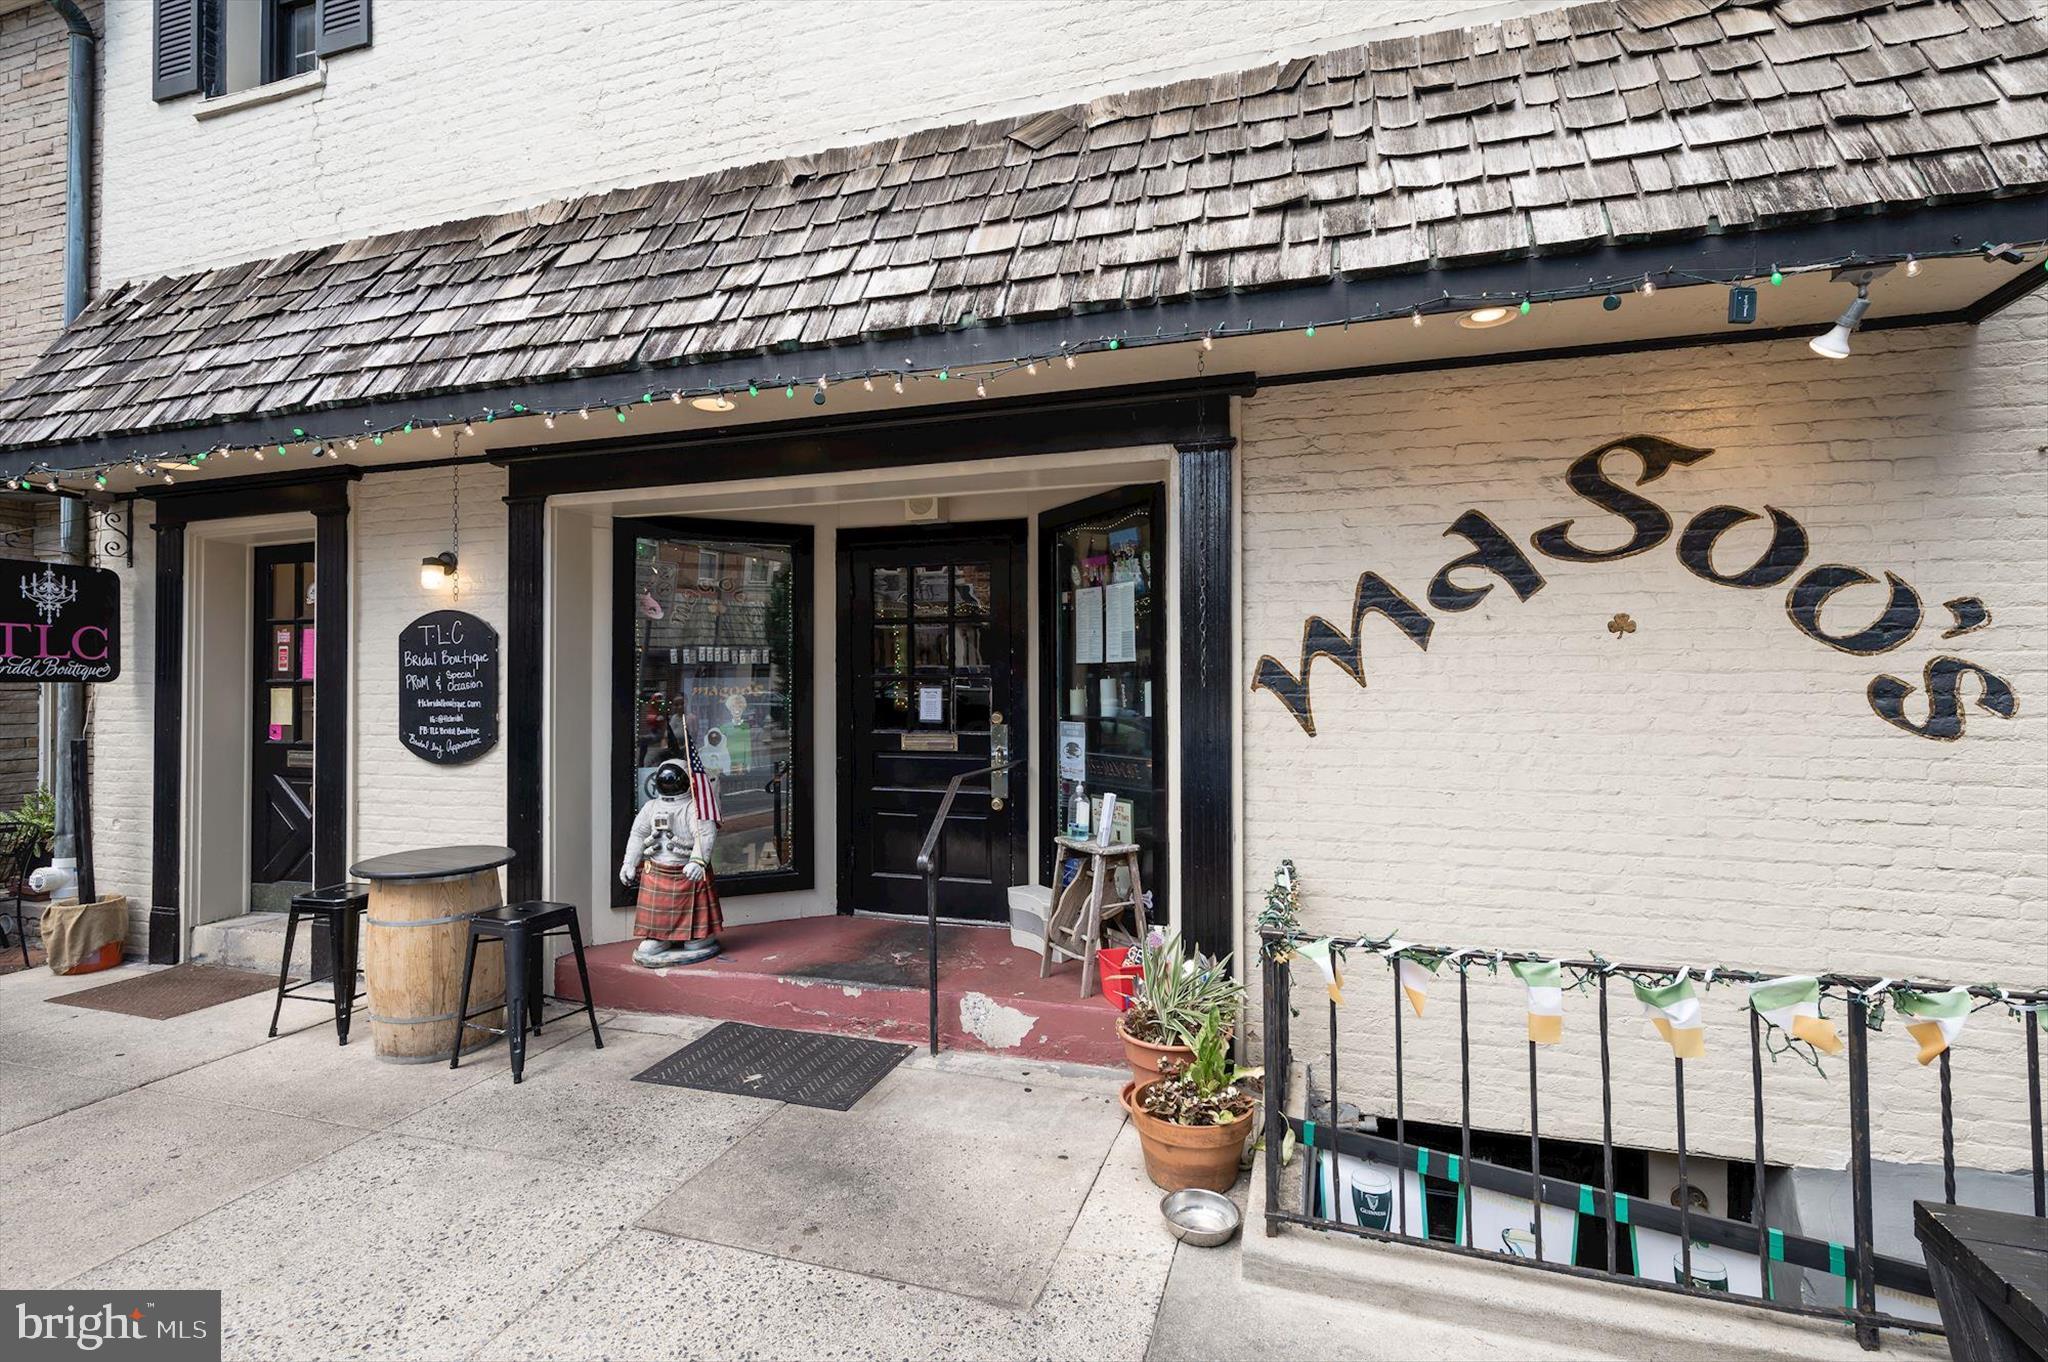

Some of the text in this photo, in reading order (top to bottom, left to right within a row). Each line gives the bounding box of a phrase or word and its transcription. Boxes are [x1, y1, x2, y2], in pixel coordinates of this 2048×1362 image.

[0, 622, 109, 661] TLC
[39, 656, 111, 681] Boutique
[442, 649, 489, 670] Boutique
[447, 680, 483, 692] Occasion
